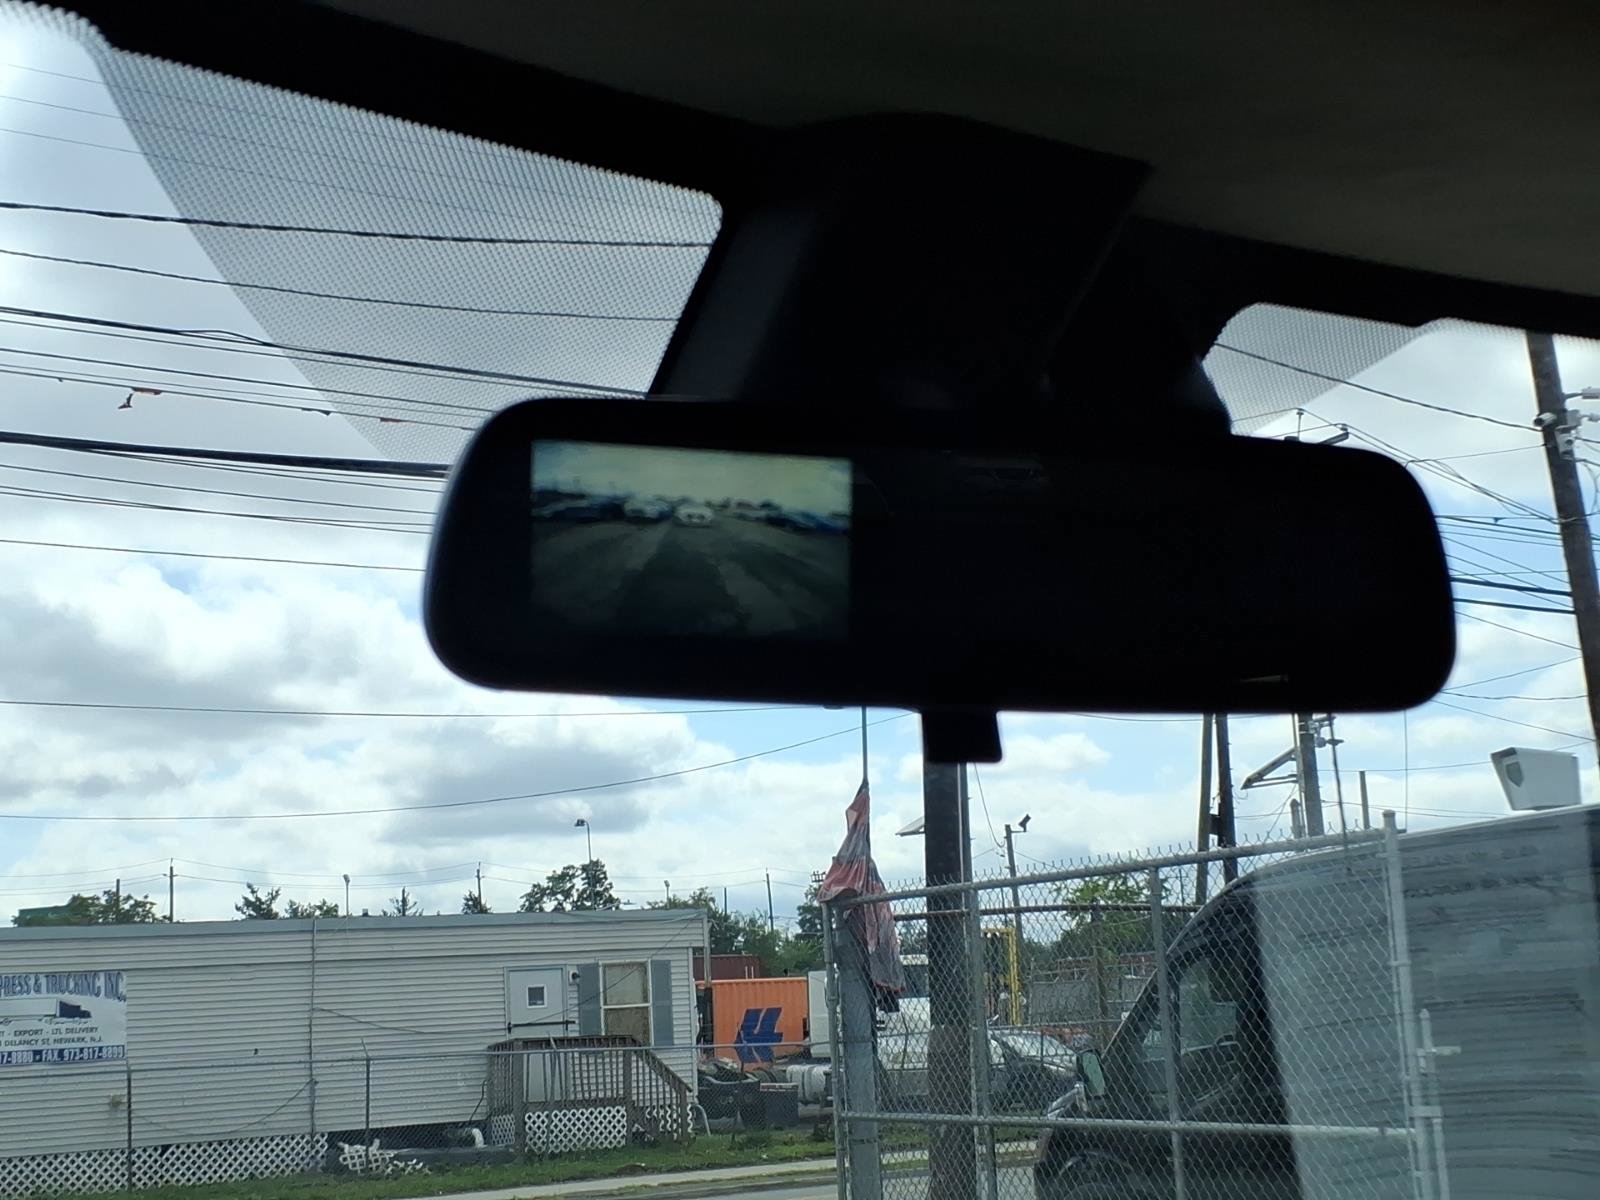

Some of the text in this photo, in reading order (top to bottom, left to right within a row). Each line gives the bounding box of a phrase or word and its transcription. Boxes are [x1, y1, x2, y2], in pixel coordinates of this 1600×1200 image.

[32, 972, 42, 995] &
[45, 971, 101, 998] TRUCKING
[13, 1028, 43, 1037] EXPORT
[65, 1026, 98, 1035] DELIVERY
